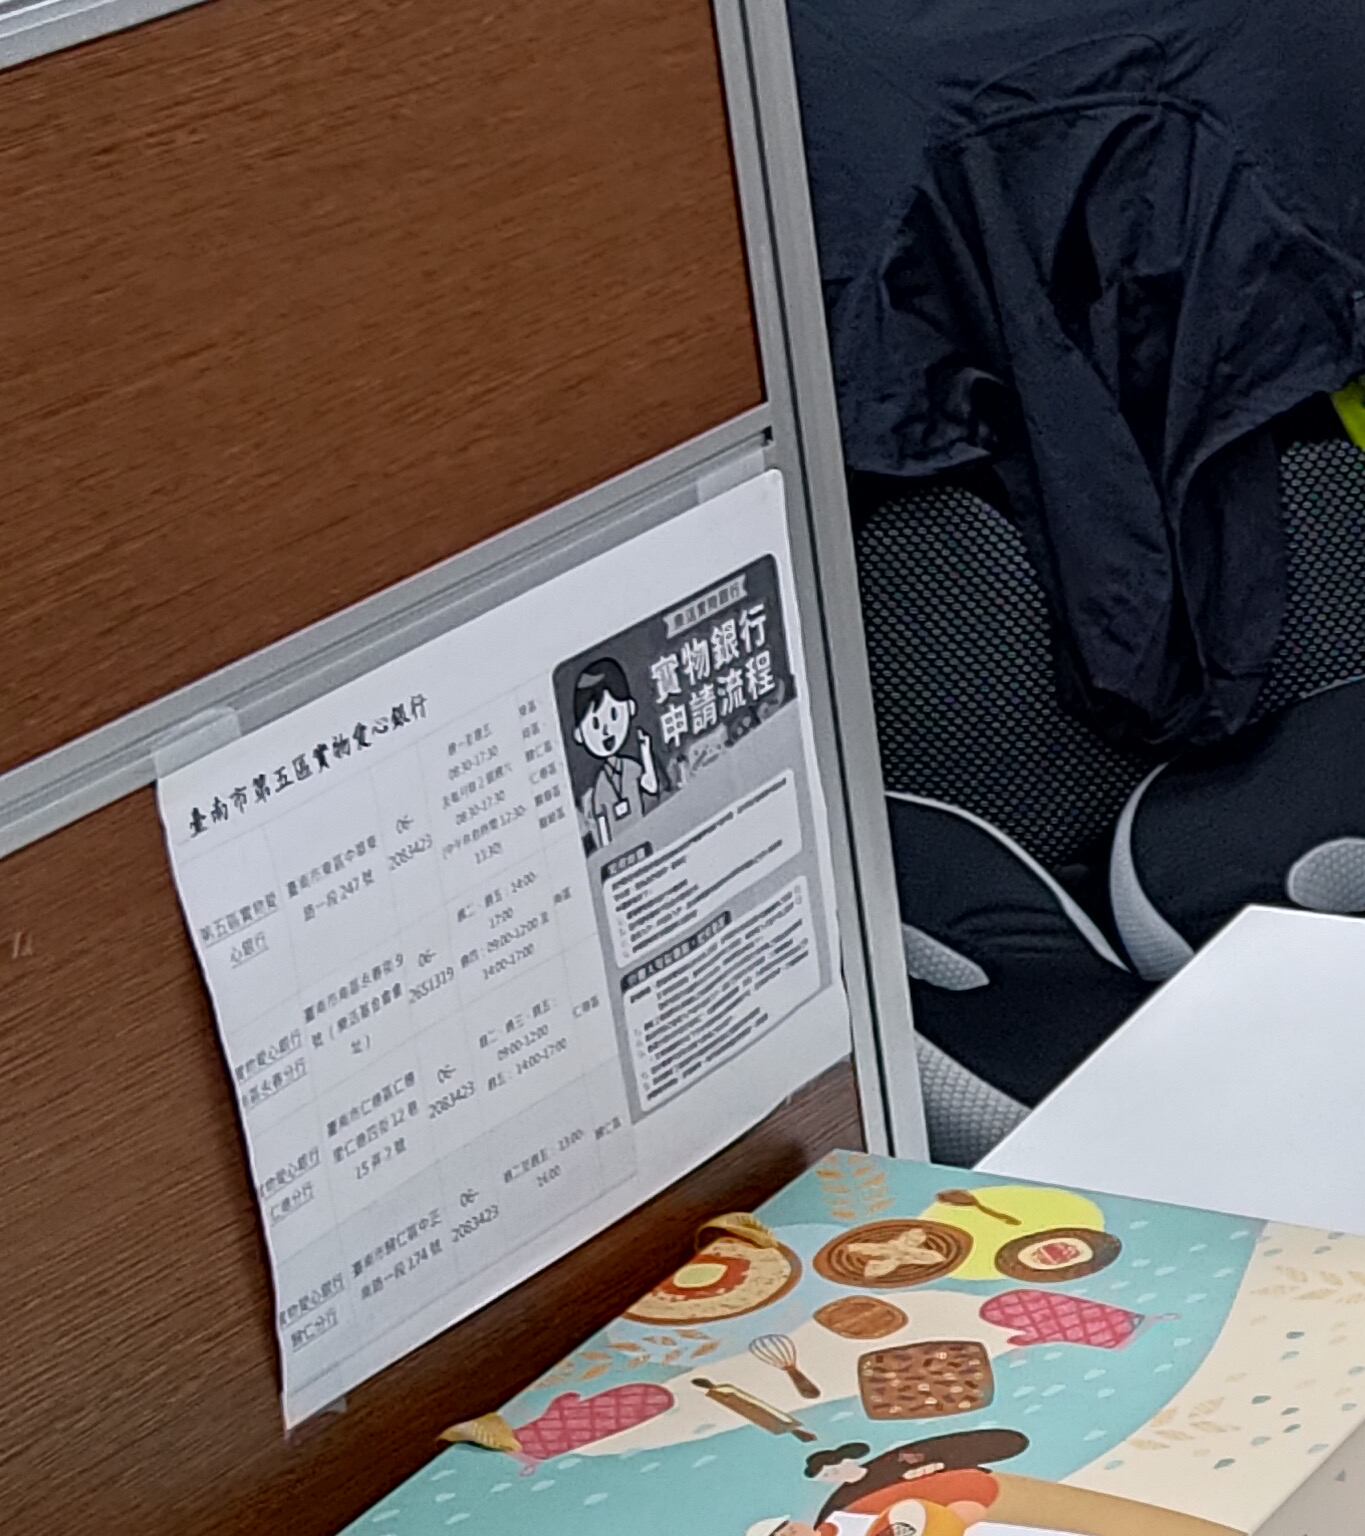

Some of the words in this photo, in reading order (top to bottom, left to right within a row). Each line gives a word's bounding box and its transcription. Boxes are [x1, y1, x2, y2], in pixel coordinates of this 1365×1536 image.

[650, 603, 766, 704] 實物銀行
[660, 650, 775, 747] 申請流程
[190, 694, 427, 838] 臺南市第五區實物愛心銀行
